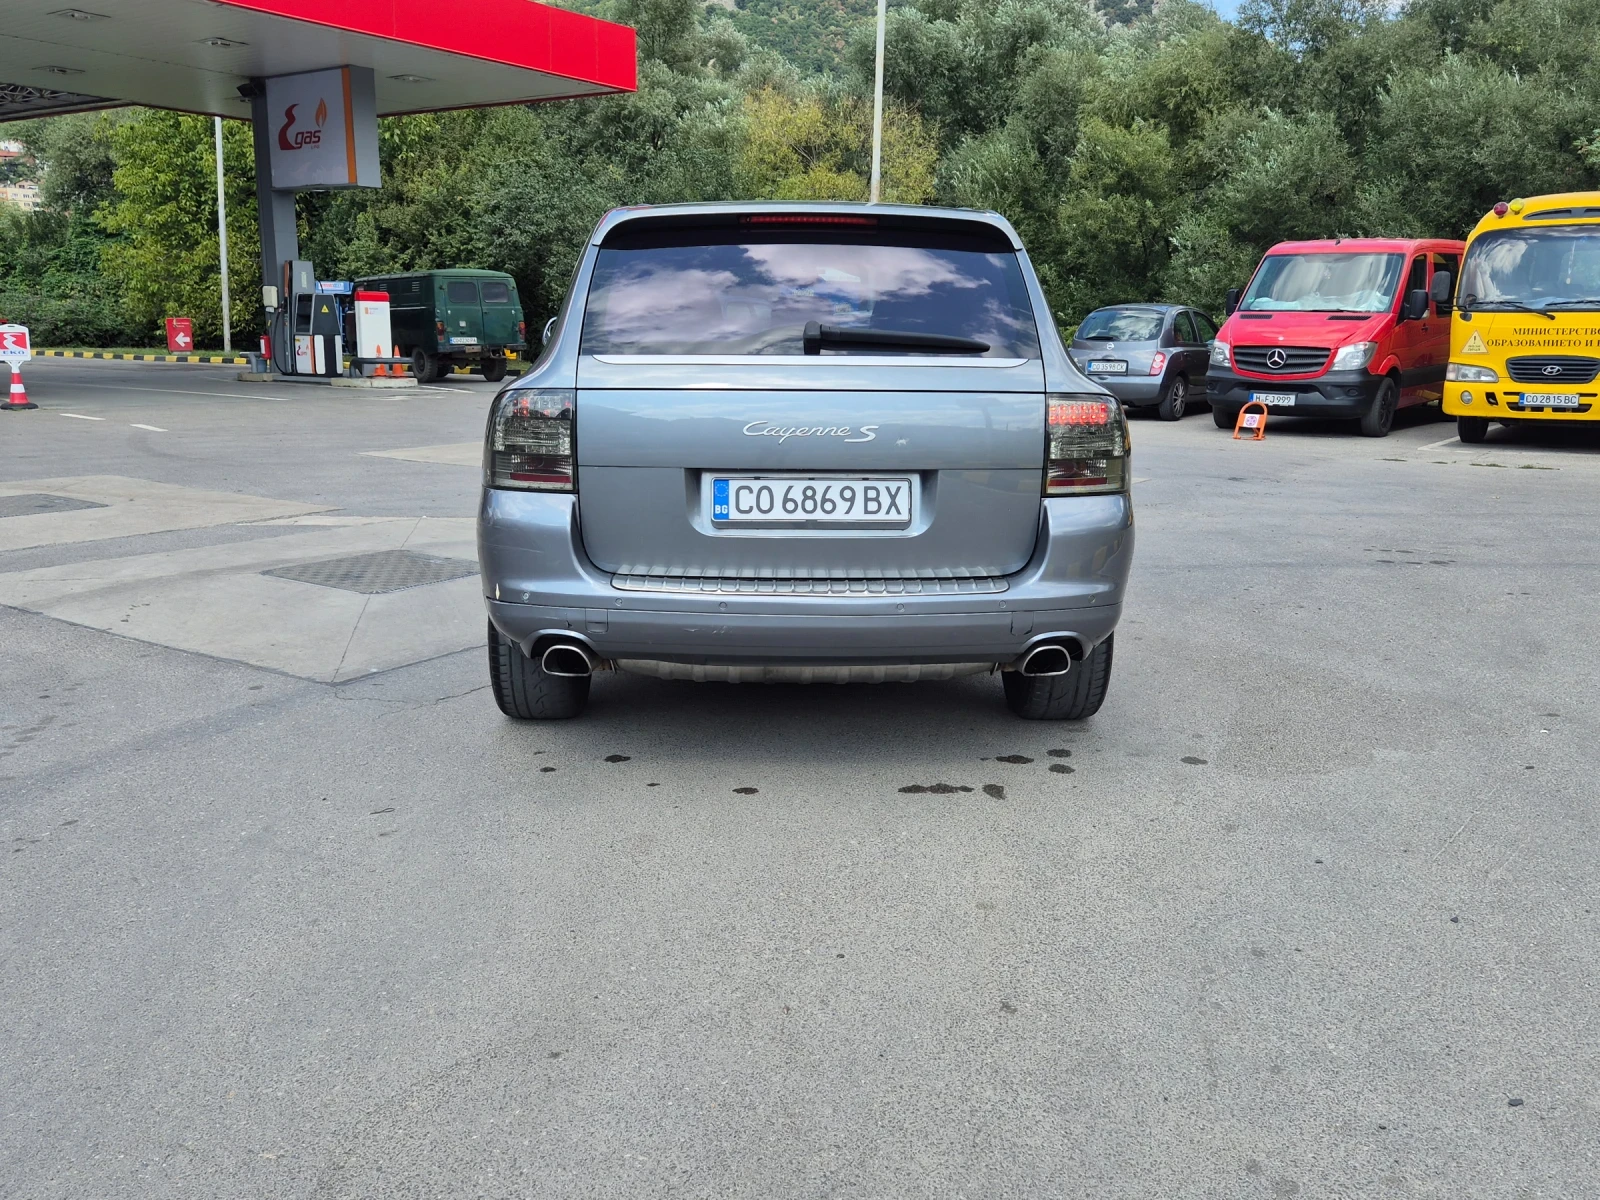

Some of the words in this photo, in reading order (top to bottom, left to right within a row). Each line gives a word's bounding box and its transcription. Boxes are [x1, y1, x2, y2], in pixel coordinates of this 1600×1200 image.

[1486, 338, 1582, 347] ОБРАЗОВАНИЕТО
[1585, 339, 1593, 347] И
[742, 420, 852, 445] Cayenne
[844, 425, 880, 443] S
[735, 485, 775, 515] CO
[781, 485, 857, 515] 6869
[863, 485, 902, 515] BX
[714, 504, 728, 514] BG
